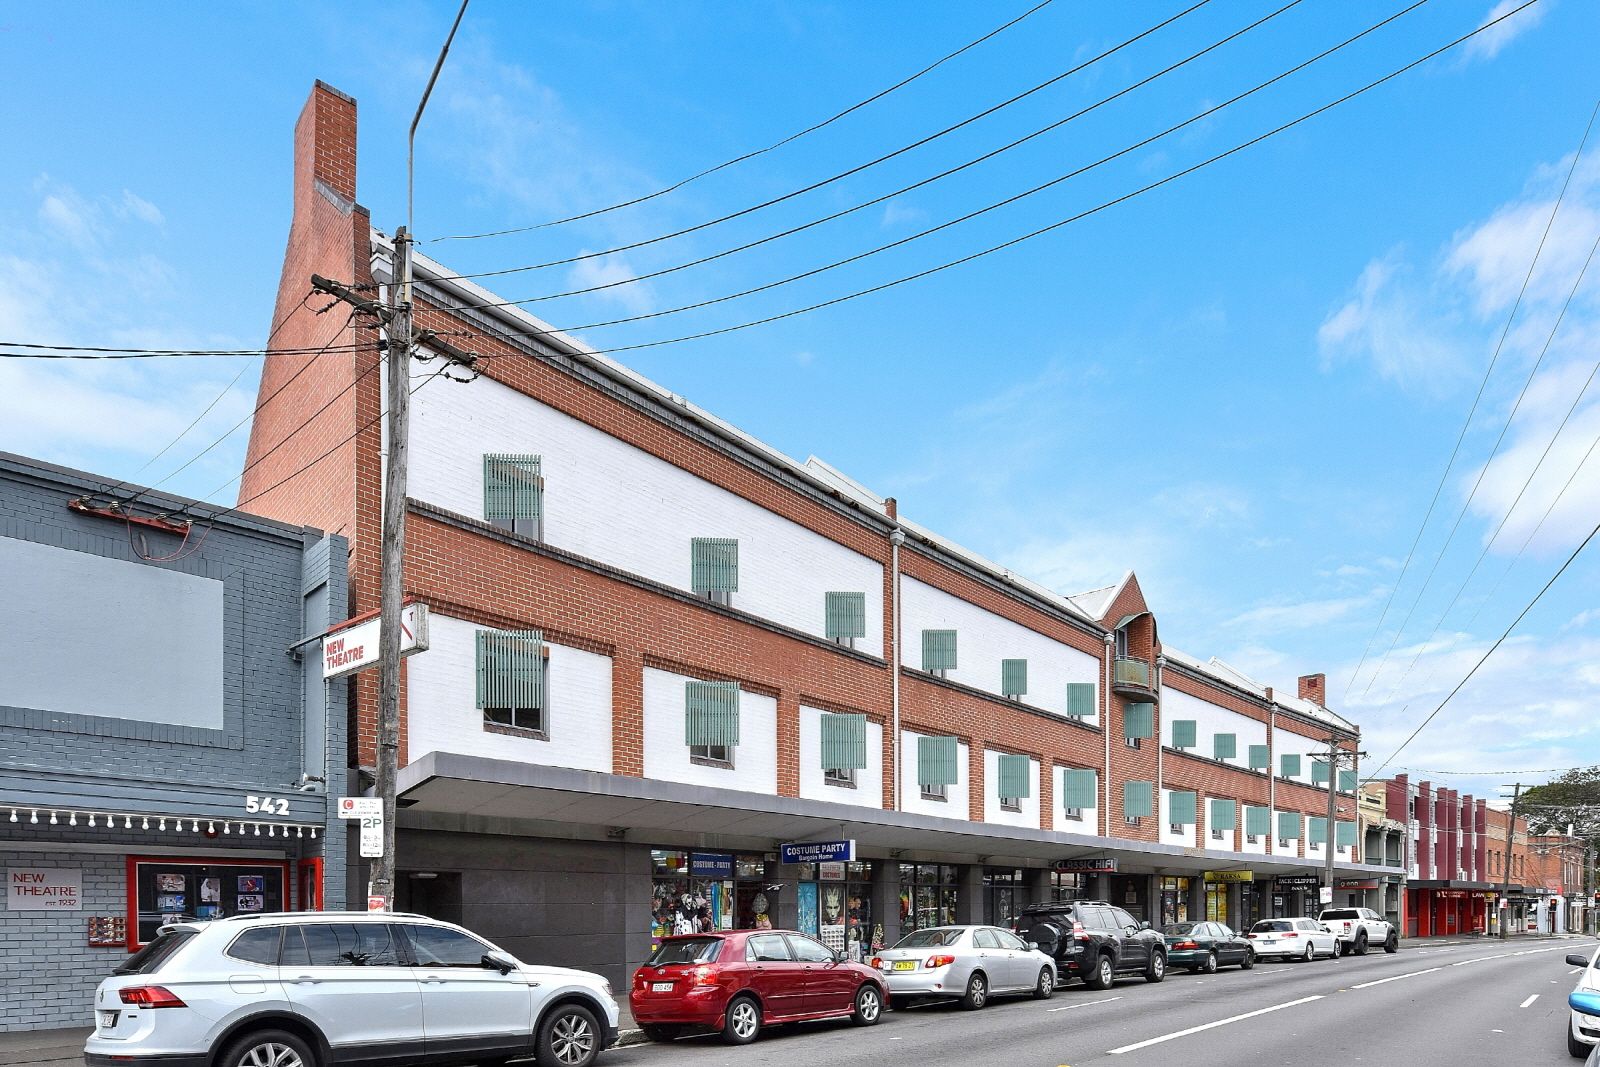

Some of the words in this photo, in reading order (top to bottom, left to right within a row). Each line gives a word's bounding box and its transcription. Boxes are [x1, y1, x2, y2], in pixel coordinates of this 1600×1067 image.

[326, 638, 345, 657] NEW
[326, 645, 364, 670] THEATRE
[246, 795, 290, 816] 542
[363, 818, 382, 828] 2P
[787, 845, 820, 856] COSTUME
[822, 843, 845, 853] PARTY
[1056, 860, 1094, 869] CLASSIC
[13, 873, 45, 883] NEW
[13, 885, 77, 897] THEATRE
